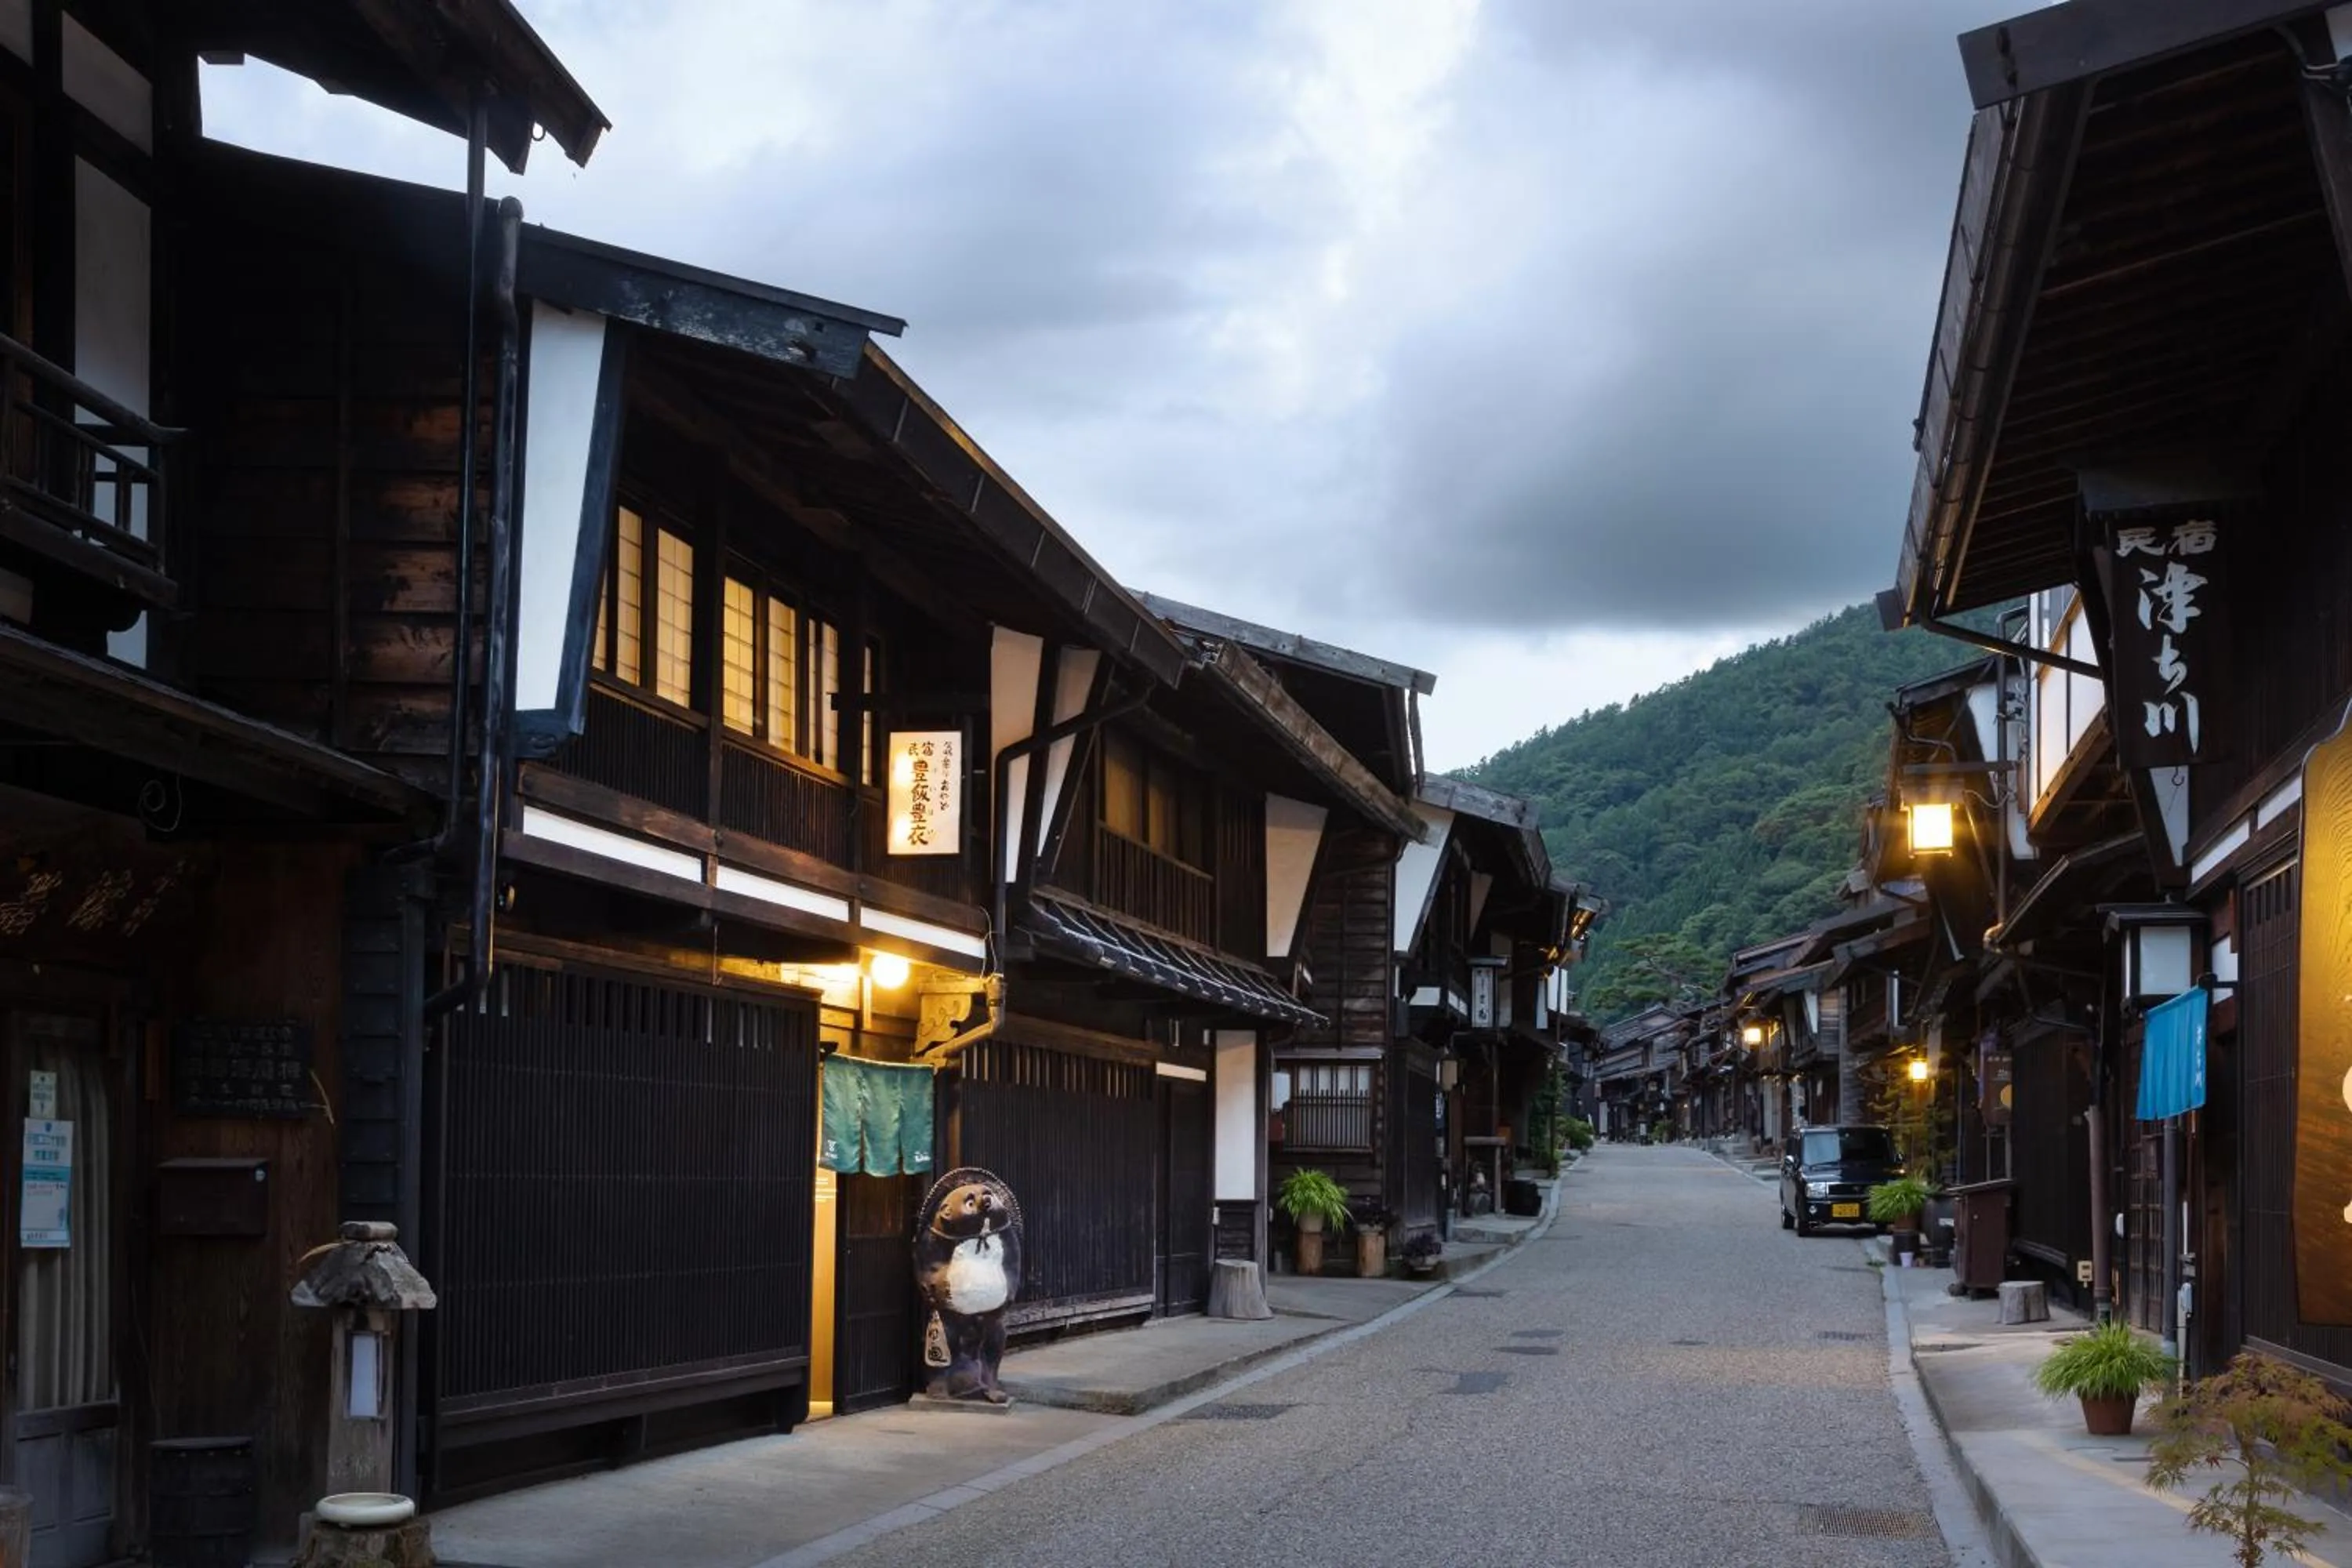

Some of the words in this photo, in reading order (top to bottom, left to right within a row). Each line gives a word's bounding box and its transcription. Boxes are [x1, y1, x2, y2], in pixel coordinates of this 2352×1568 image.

[2116, 521, 2217, 557] 民宿
[2138, 561, 2208, 753] 津ち川
[908, 741, 935, 757] 民宿
[908, 759, 931, 846] 豊飯豊衣
